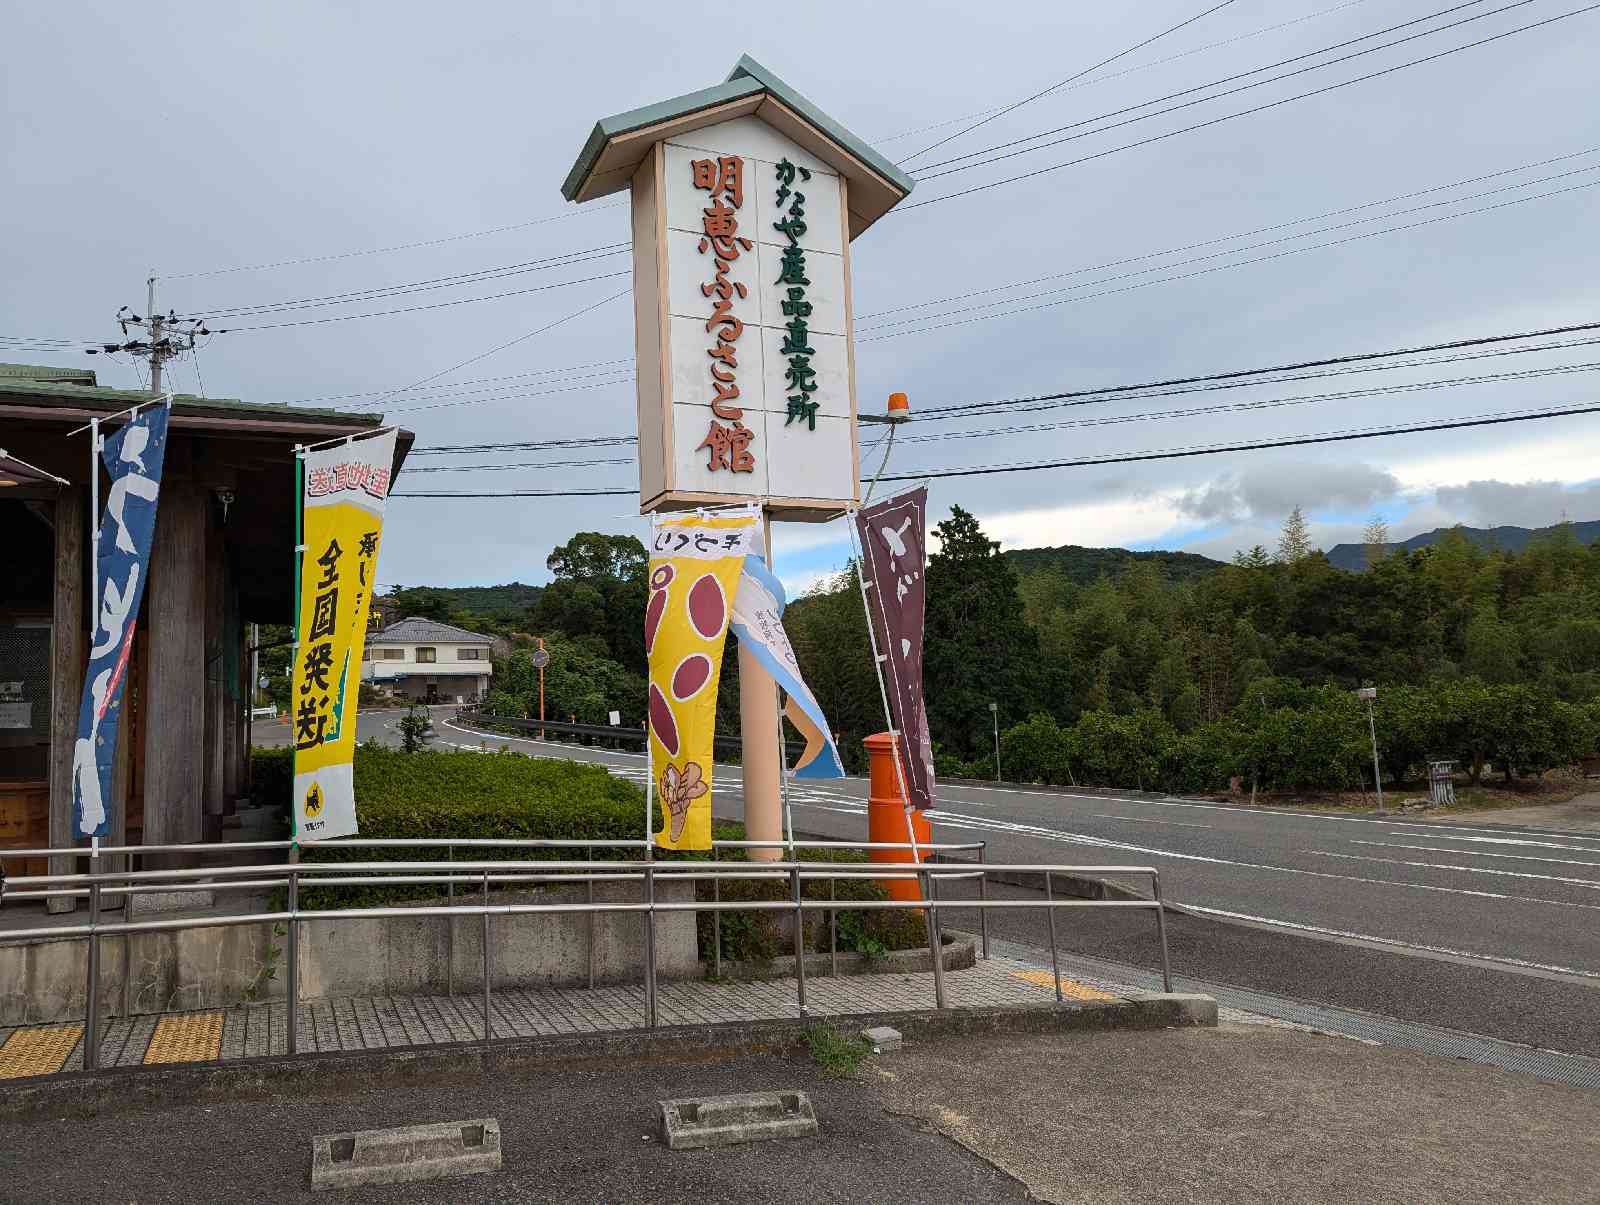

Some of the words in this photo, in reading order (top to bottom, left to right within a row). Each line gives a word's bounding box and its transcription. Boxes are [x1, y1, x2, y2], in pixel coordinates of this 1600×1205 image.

[691, 157, 754, 473] 明恵ふるさと館
[773, 157, 820, 431] かなや産品直売所
